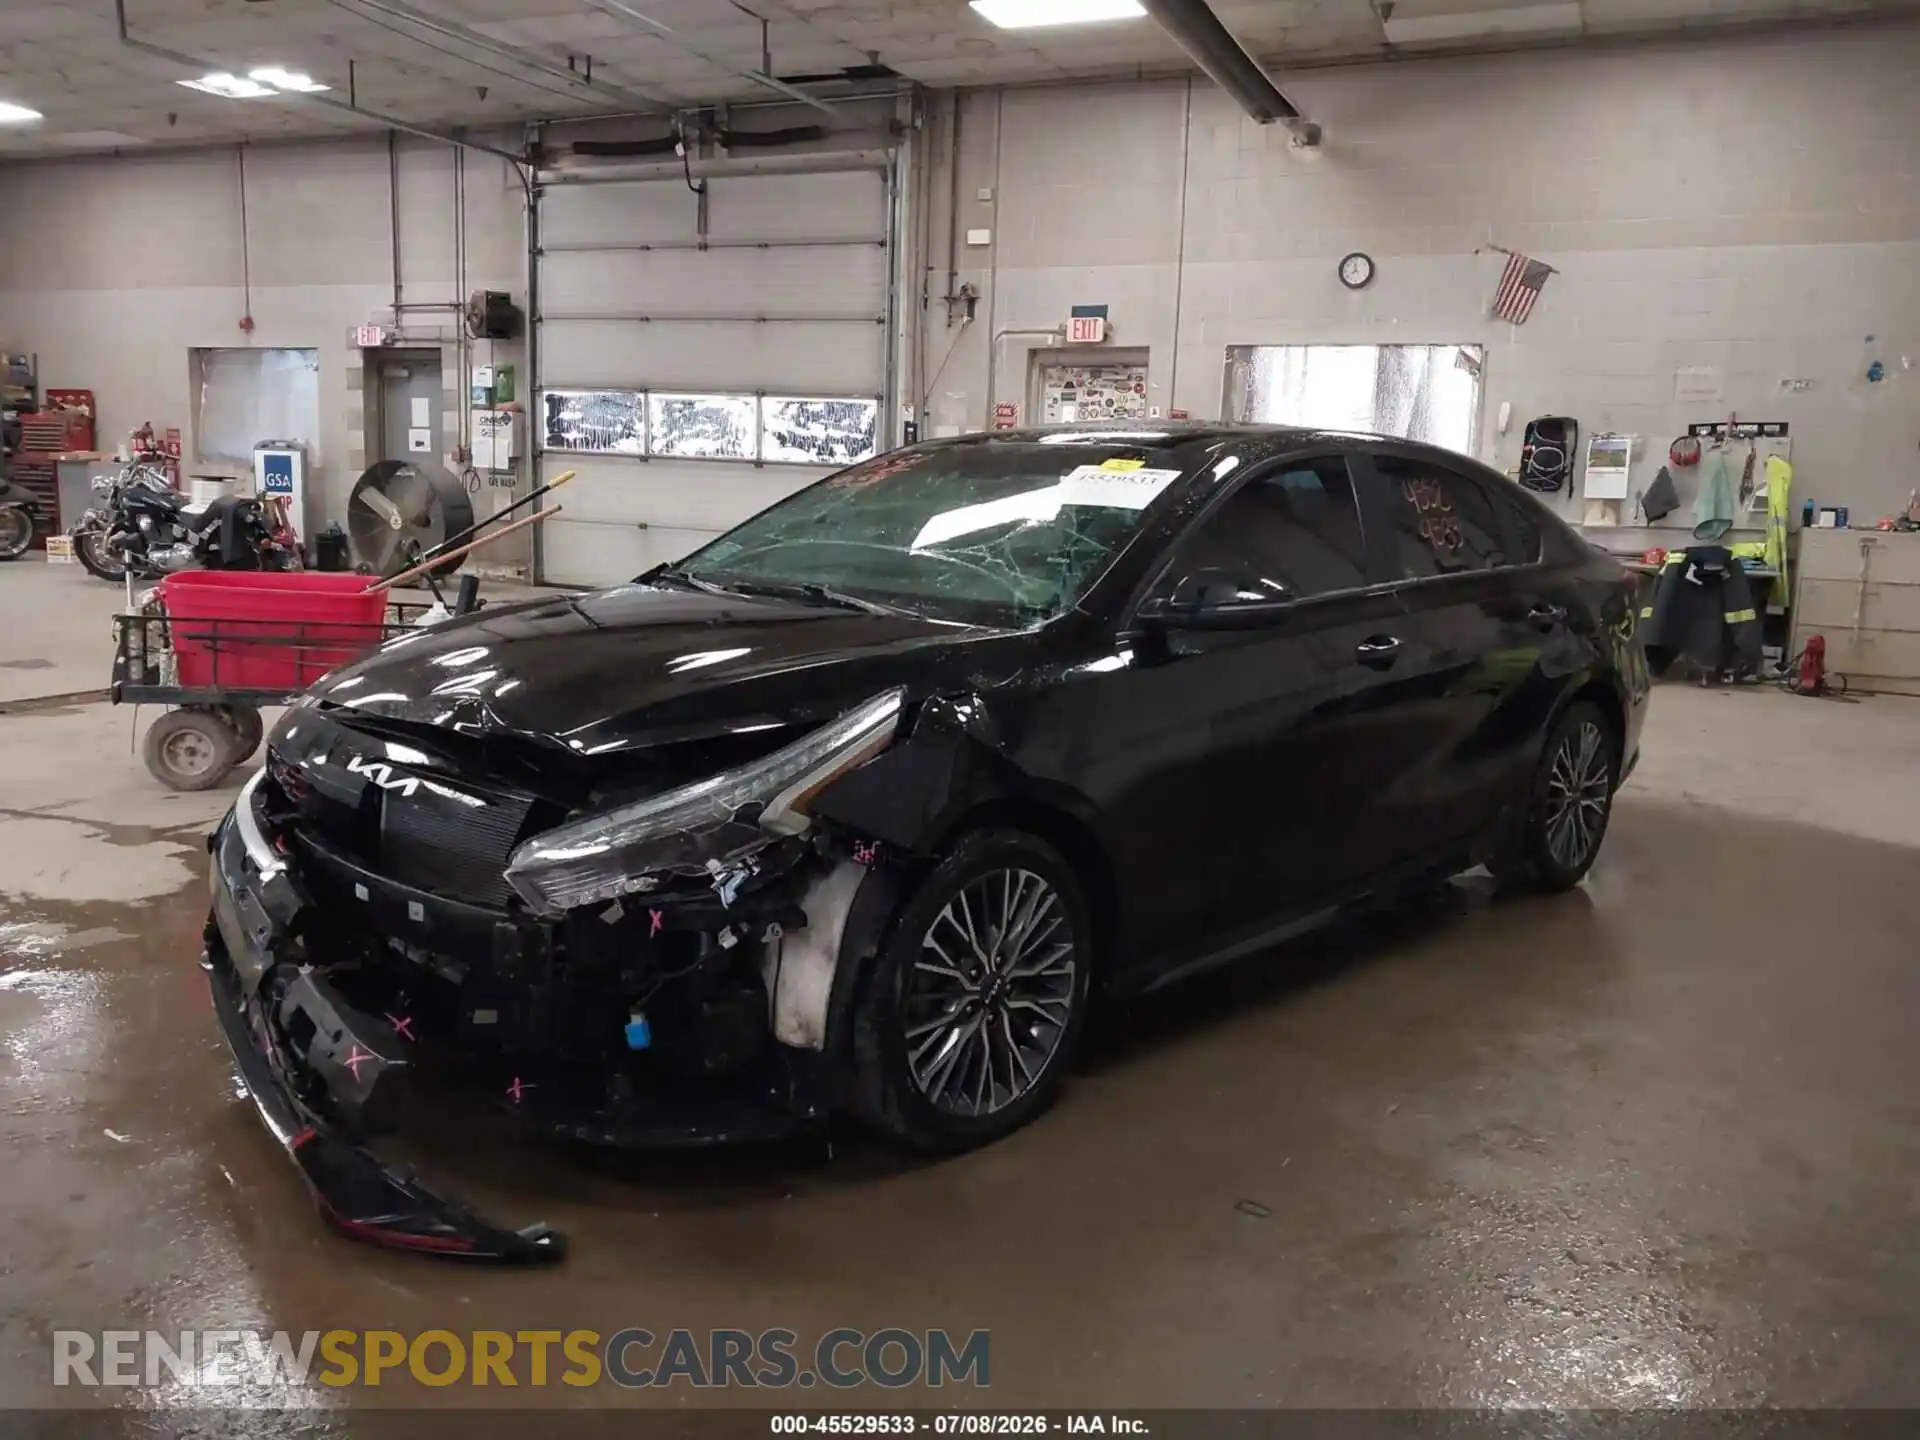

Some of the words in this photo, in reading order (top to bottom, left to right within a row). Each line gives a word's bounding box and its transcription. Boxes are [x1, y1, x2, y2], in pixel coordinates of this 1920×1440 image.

[361, 327, 377, 345] EXIT
[1073, 318, 1099, 340] EXIT
[266, 472, 291, 488] GSA
[346, 755, 421, 797] KIA
